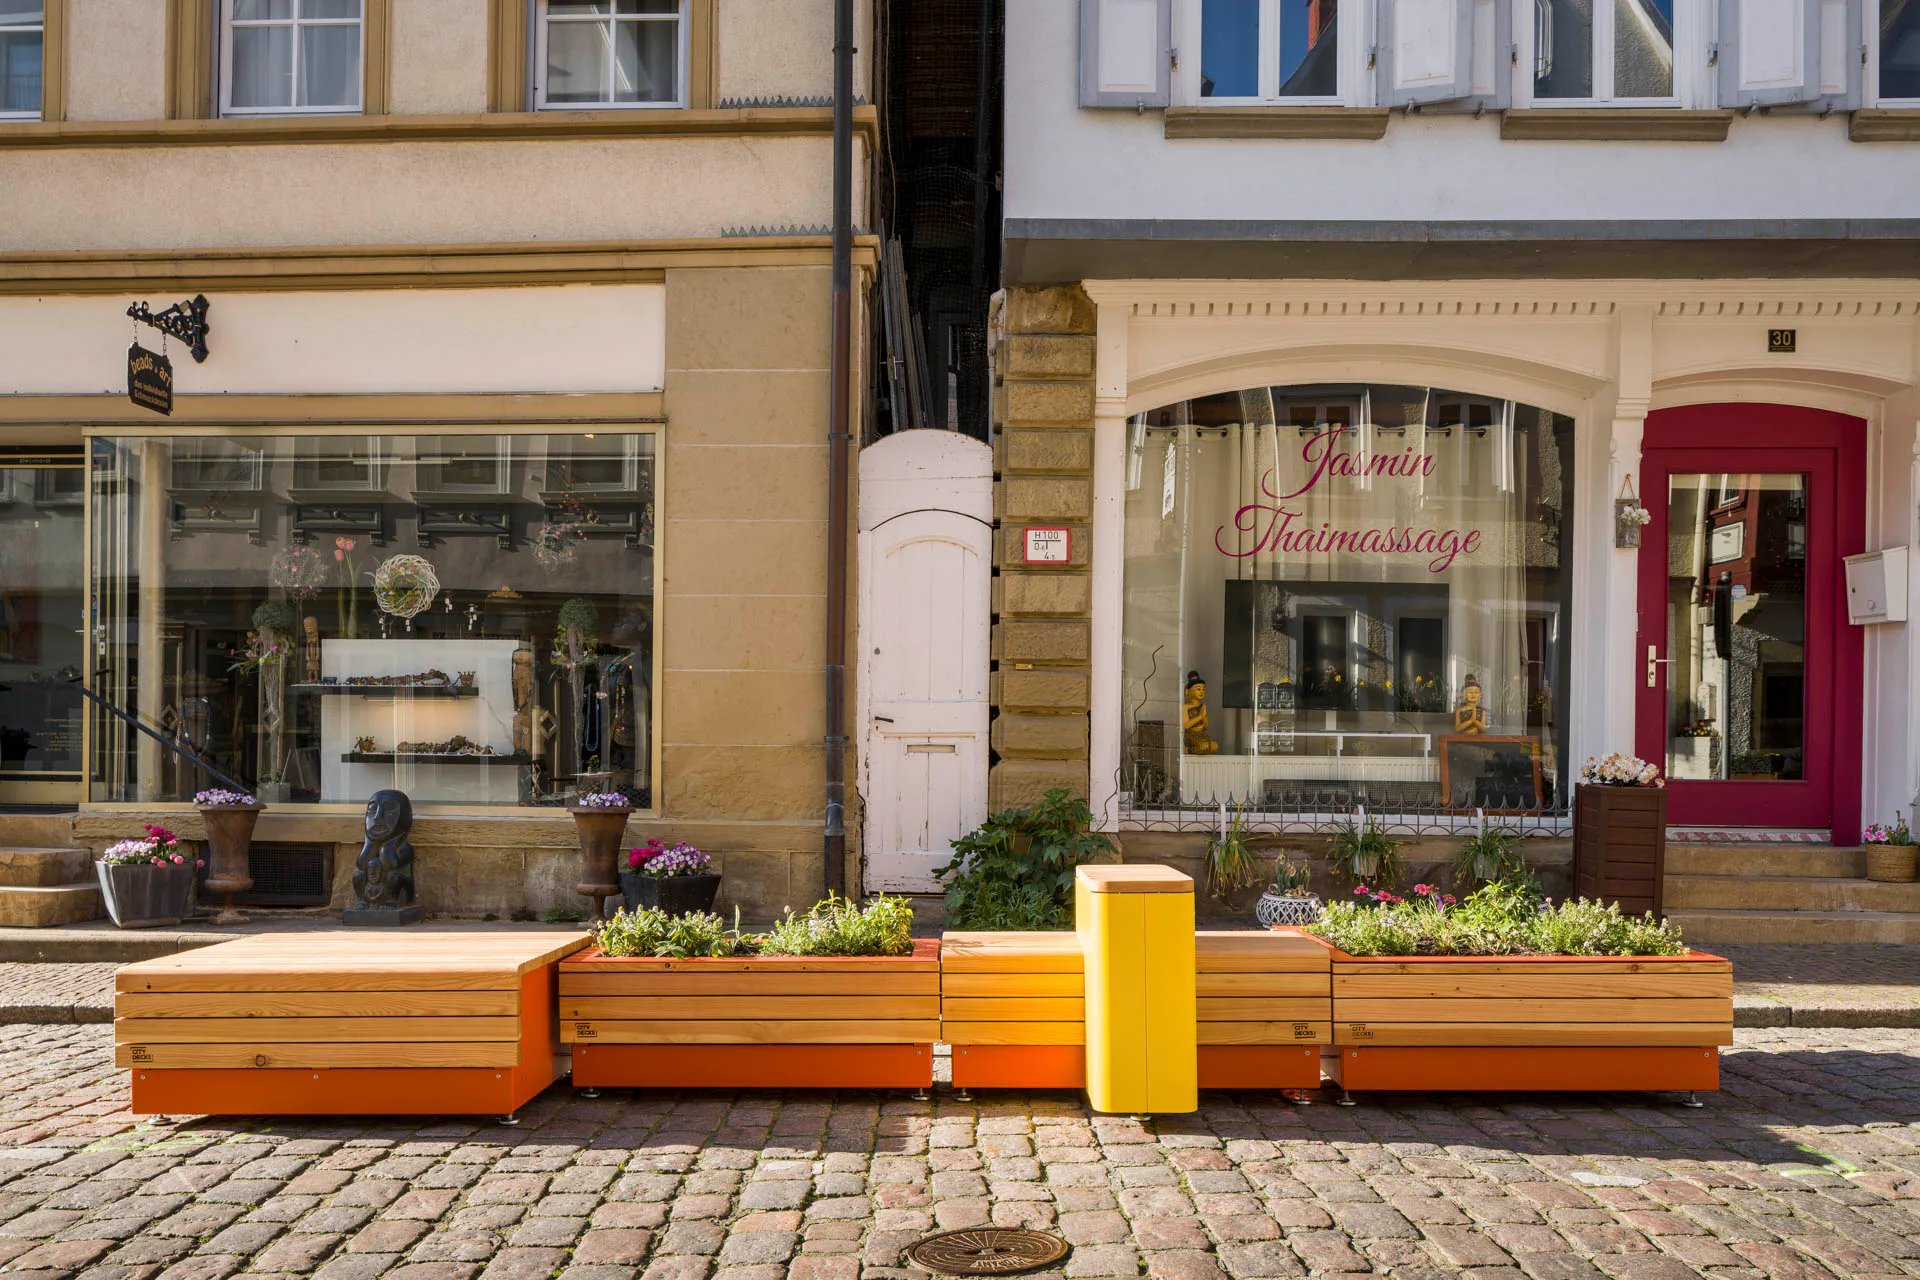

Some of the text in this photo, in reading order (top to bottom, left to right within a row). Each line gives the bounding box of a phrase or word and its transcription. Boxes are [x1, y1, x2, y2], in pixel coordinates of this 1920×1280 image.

[1772, 331, 1791, 346] 30
[130, 353, 153, 375] beads
[1261, 424, 1436, 499] Jasmin
[1215, 504, 1481, 573] Thaimassage
